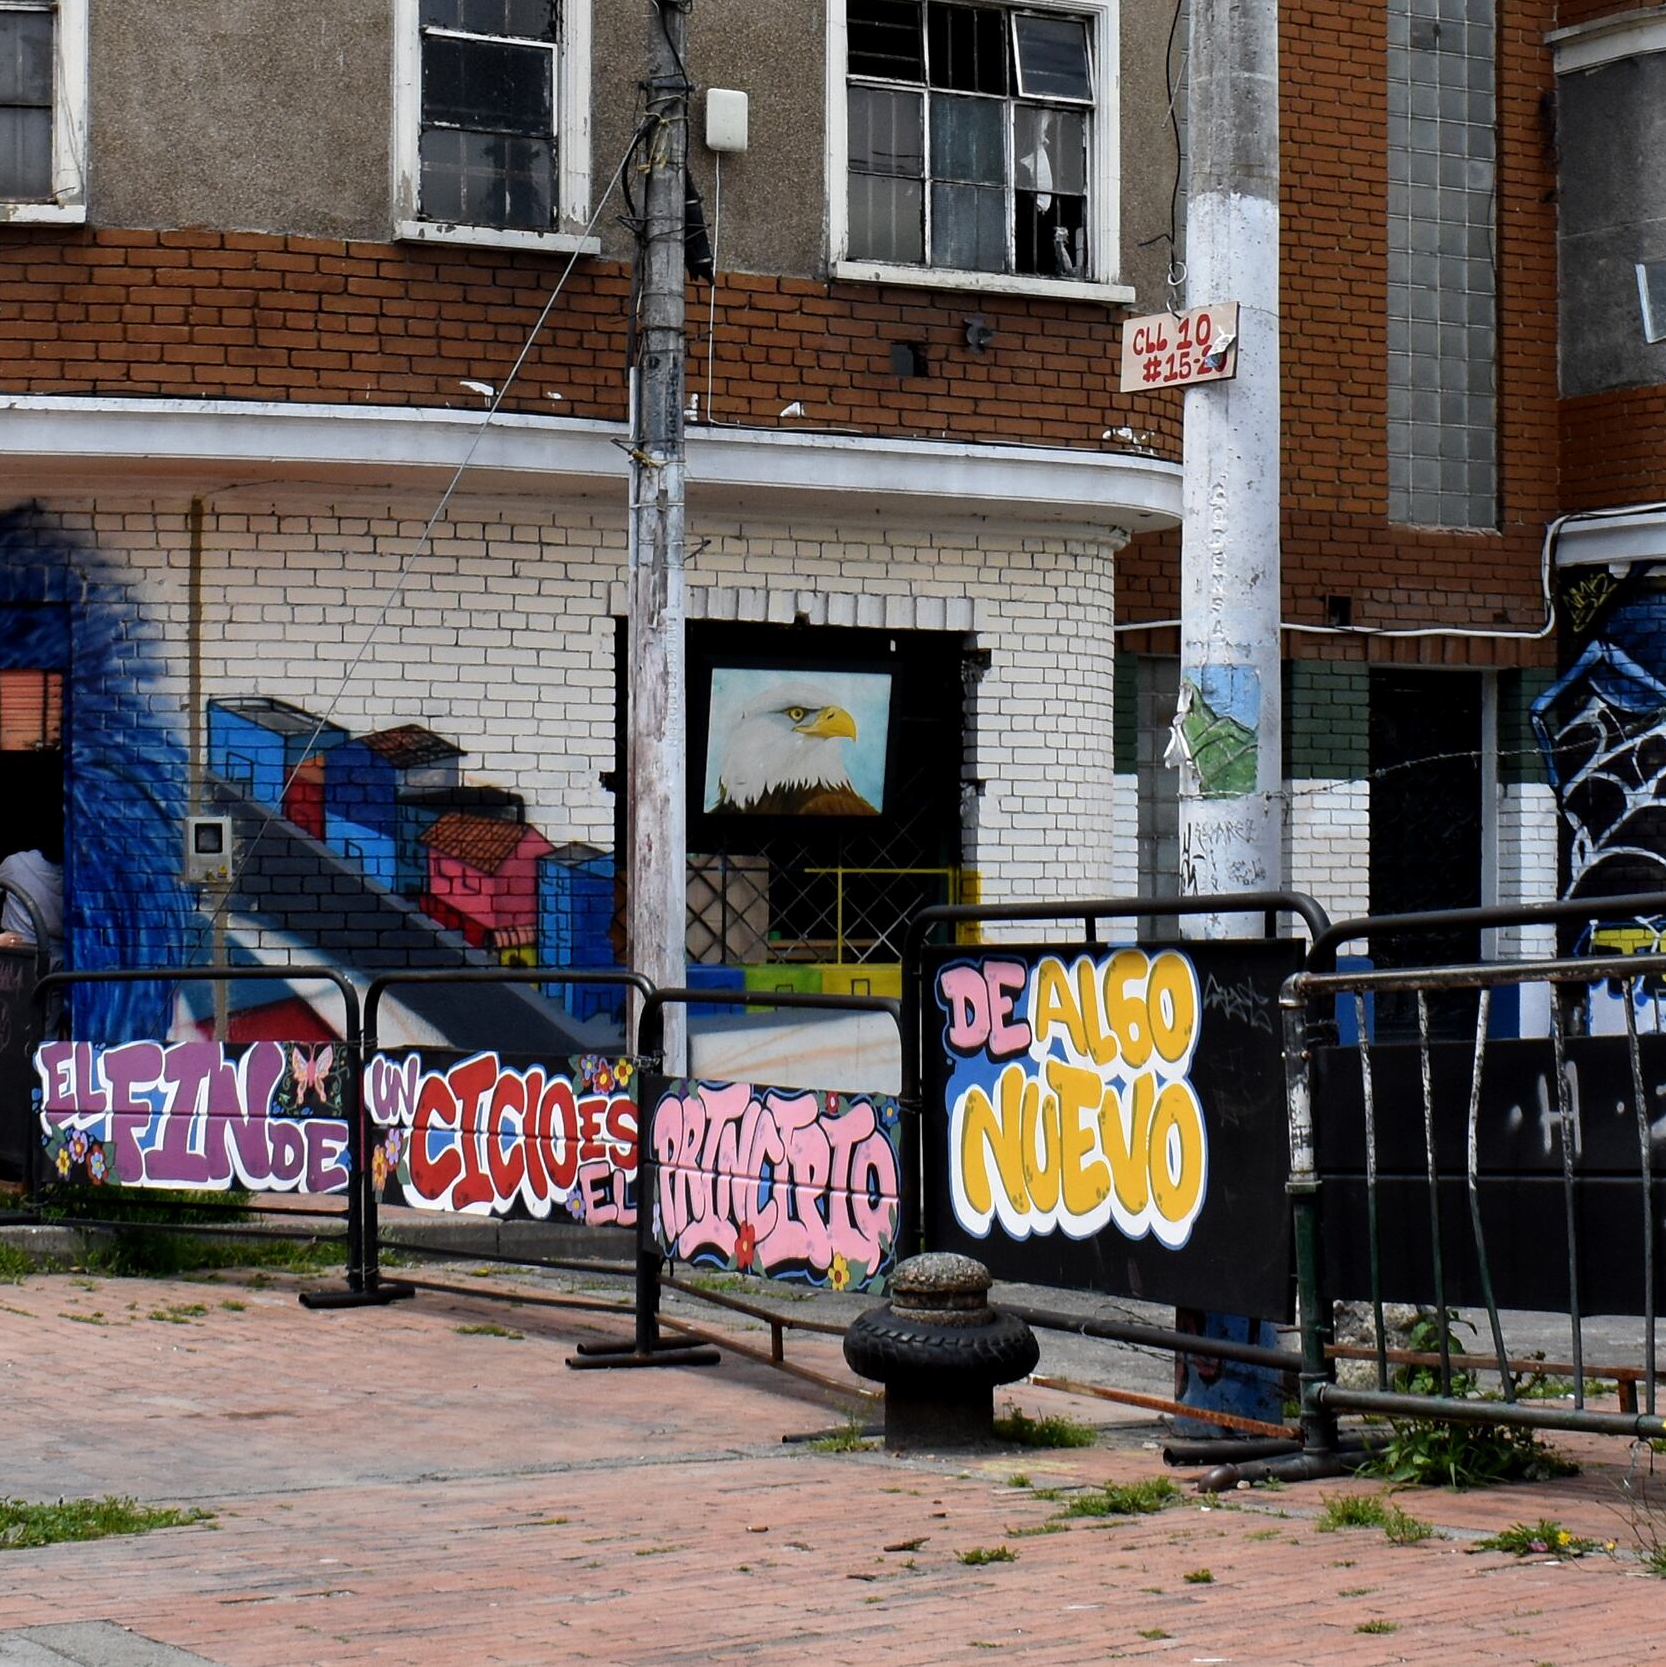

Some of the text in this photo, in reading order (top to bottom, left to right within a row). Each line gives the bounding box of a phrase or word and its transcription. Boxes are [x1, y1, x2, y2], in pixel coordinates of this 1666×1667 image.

[1176, 313, 1211, 350] 10
[938, 959, 1031, 1058] DE
[1030, 947, 1201, 1072] ALGO
[39, 1039, 349, 1194] EL FIN DE
[371, 1056, 419, 1121] UN
[578, 1099, 639, 1170] ES
[953, 1064, 1205, 1242] NUEVO
[579, 1162, 638, 1227] EL
